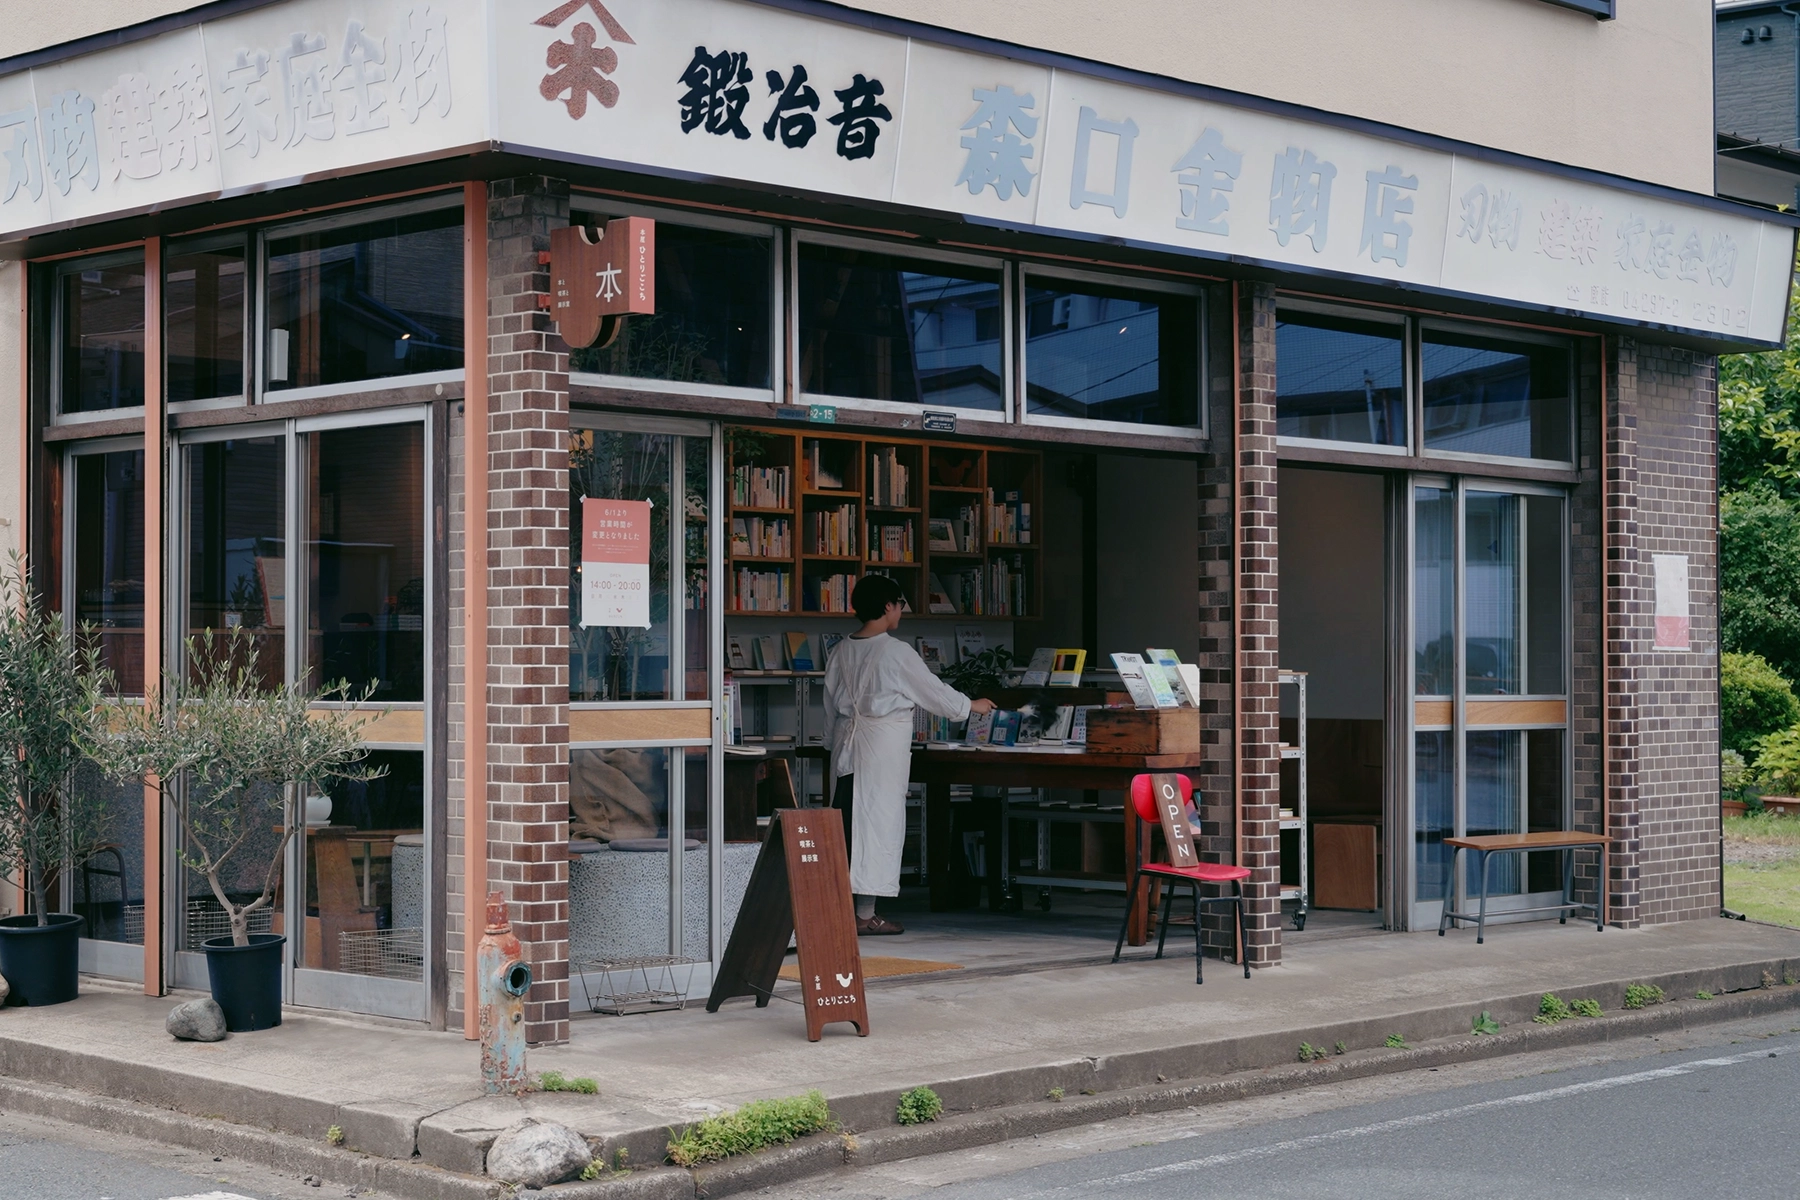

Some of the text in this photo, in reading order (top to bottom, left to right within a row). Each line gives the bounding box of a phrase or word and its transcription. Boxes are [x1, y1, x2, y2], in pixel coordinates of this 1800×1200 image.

[677, 45, 893, 161] 鍛冶音
[954, 84, 1420, 268] 森口金物店
[596, 262, 622, 302] 本
[813, 408, 833, 420] 2-15
[600, 520, 633, 529] 営業時間が
[592, 531, 640, 541] 変更となりました
[590, 580, 612, 590] 14:00
[618, 581, 641, 591] 20:00
[1162, 783, 1190, 858] OPEN
[817, 994, 857, 1007] ひとりごこち
